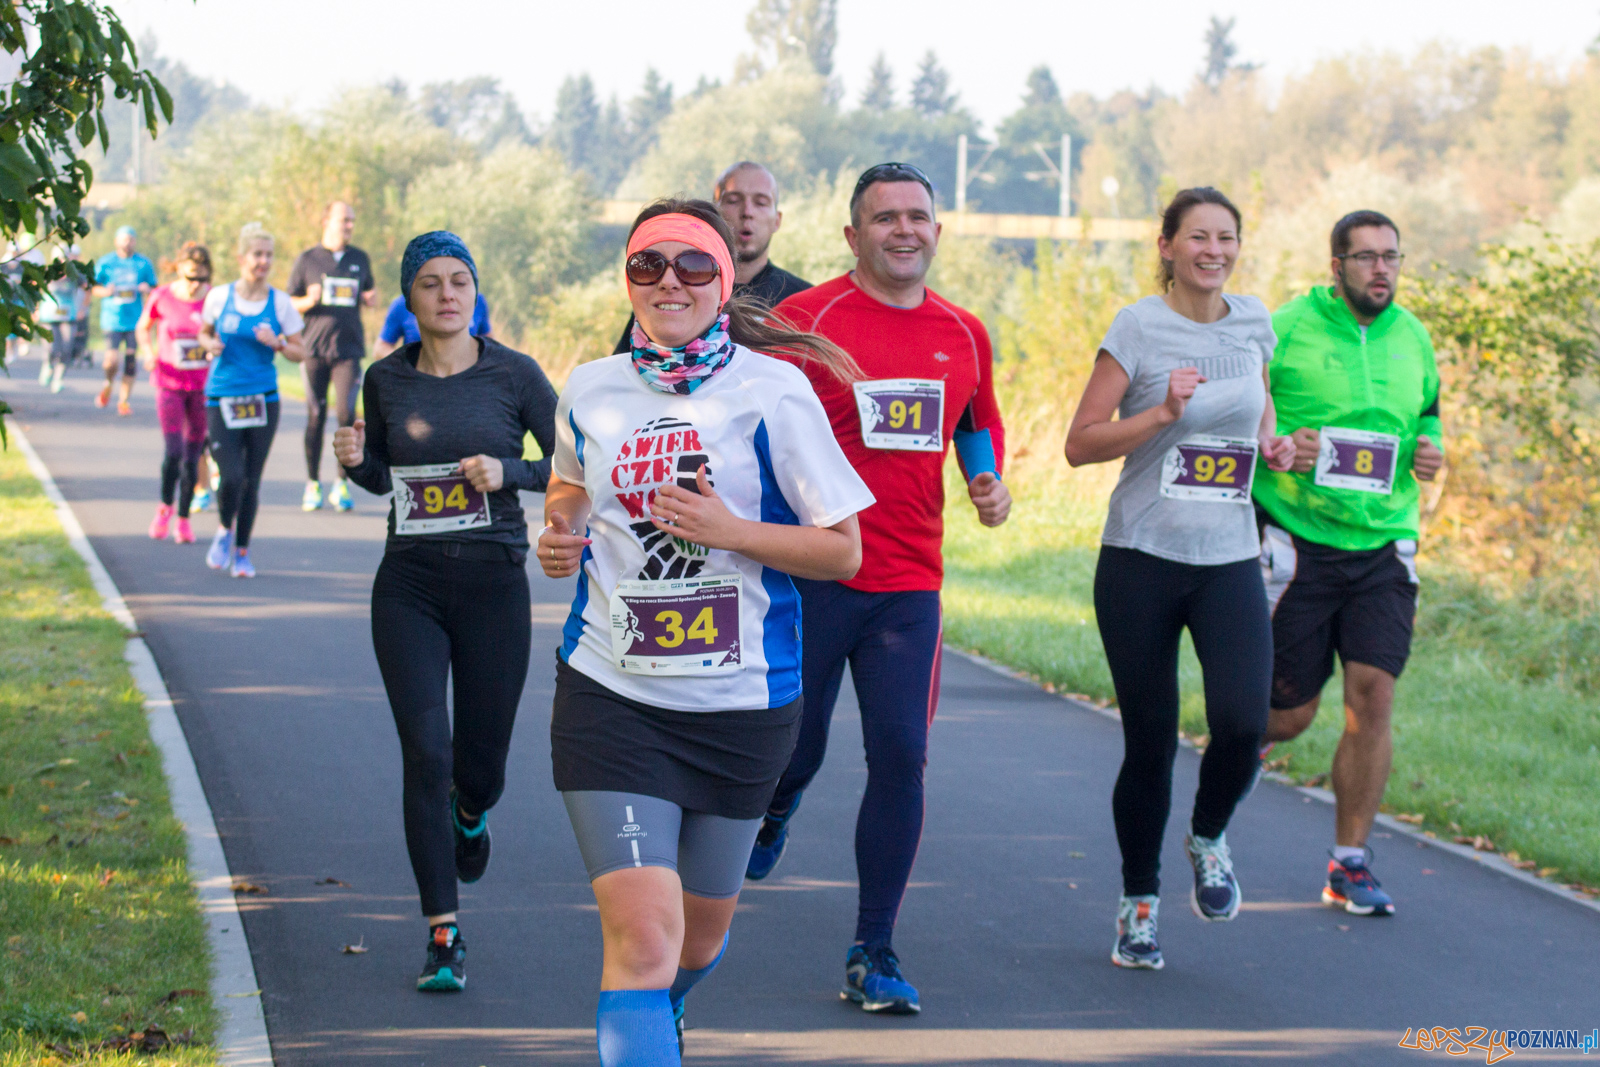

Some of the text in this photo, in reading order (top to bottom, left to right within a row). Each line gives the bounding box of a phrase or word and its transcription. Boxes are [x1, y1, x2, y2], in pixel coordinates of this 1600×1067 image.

[889, 400, 922, 430] 91
[611, 456, 674, 489] CZE
[1194, 455, 1237, 484] 92
[1355, 449, 1374, 475] 8
[423, 483, 469, 514] 94
[654, 606, 719, 648] 34
